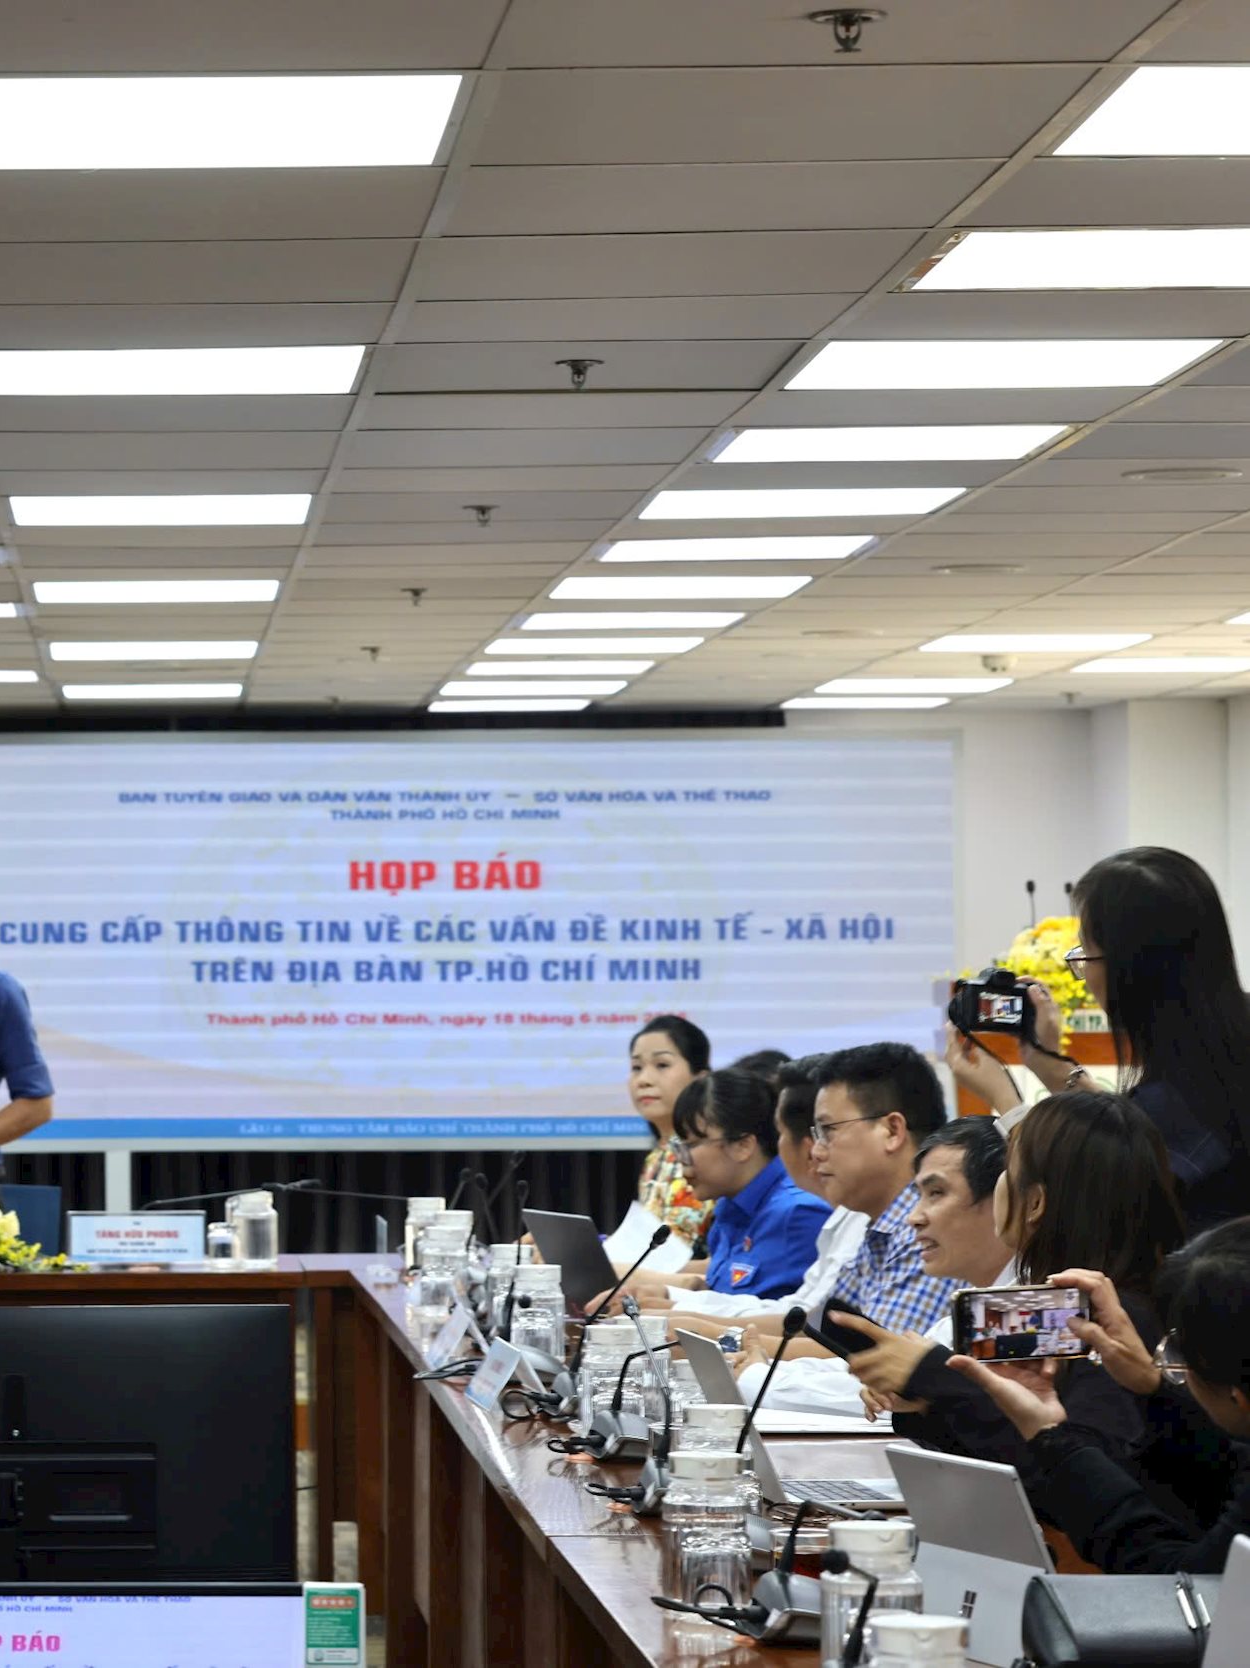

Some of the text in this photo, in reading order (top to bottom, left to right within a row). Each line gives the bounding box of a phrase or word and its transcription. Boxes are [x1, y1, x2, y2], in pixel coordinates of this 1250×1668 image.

[118, 792, 157, 804] BAN
[723, 790, 772, 801] THAO
[510, 808, 560, 820] MINH
[349, 851, 542, 897] HỌP BÁO
[100, 914, 163, 944] CẤP
[175, 916, 285, 944] THÔNG
[296, 920, 352, 943] TIN
[364, 914, 402, 943] VỀ
[413, 914, 477, 943] CÁC
[489, 912, 556, 943] VẤN
[568, 912, 607, 942] ĐỀ
[620, 919, 701, 942] KINH
[715, 911, 753, 941] TẾ
[785, 913, 827, 940] XÃ
[839, 913, 894, 944] HỘI
[191, 954, 701, 987] TRÊN ĐỊA BÀN TP.HỒ CHÍ MINH
[11, 1630, 61, 1652] BÁO
